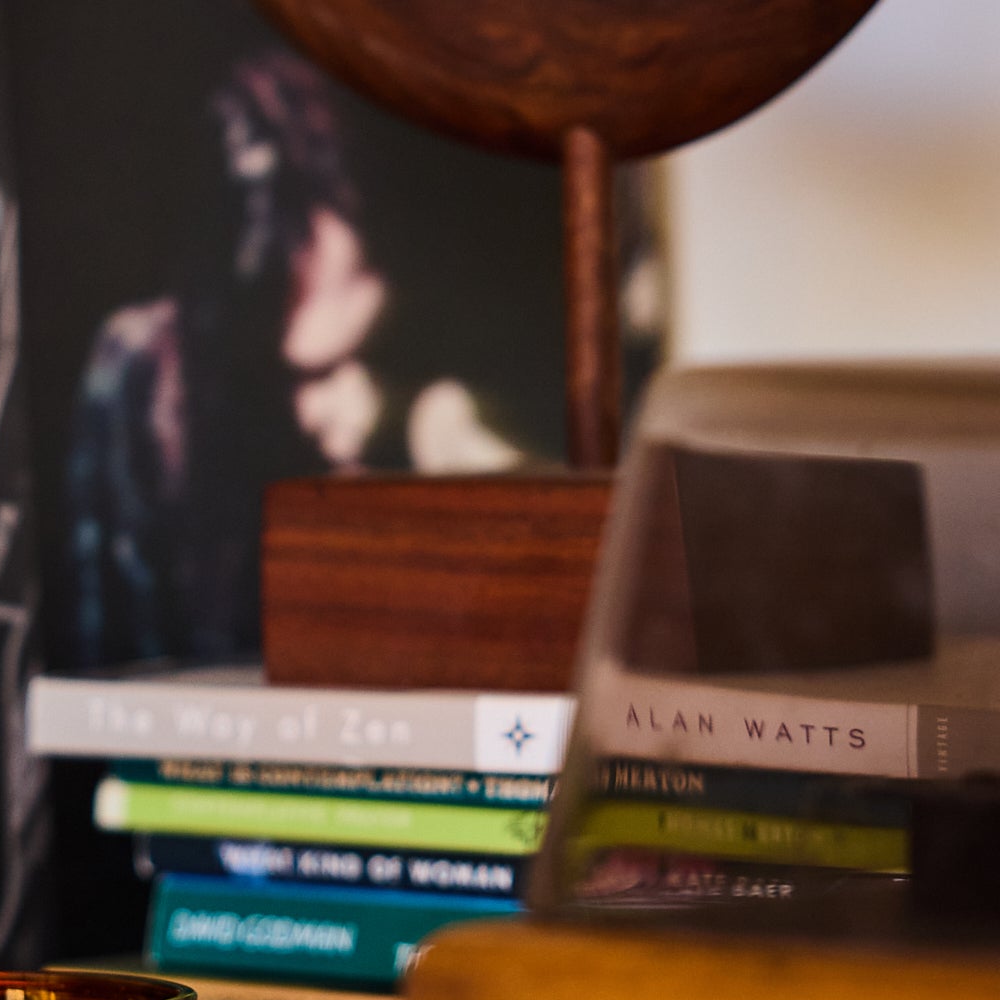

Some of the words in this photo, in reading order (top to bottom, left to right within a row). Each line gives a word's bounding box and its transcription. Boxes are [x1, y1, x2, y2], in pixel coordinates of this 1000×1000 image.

[340, 707, 411, 746] Zen
[625, 702, 714, 735] ALAN
[744, 716, 866, 750] WATTS
